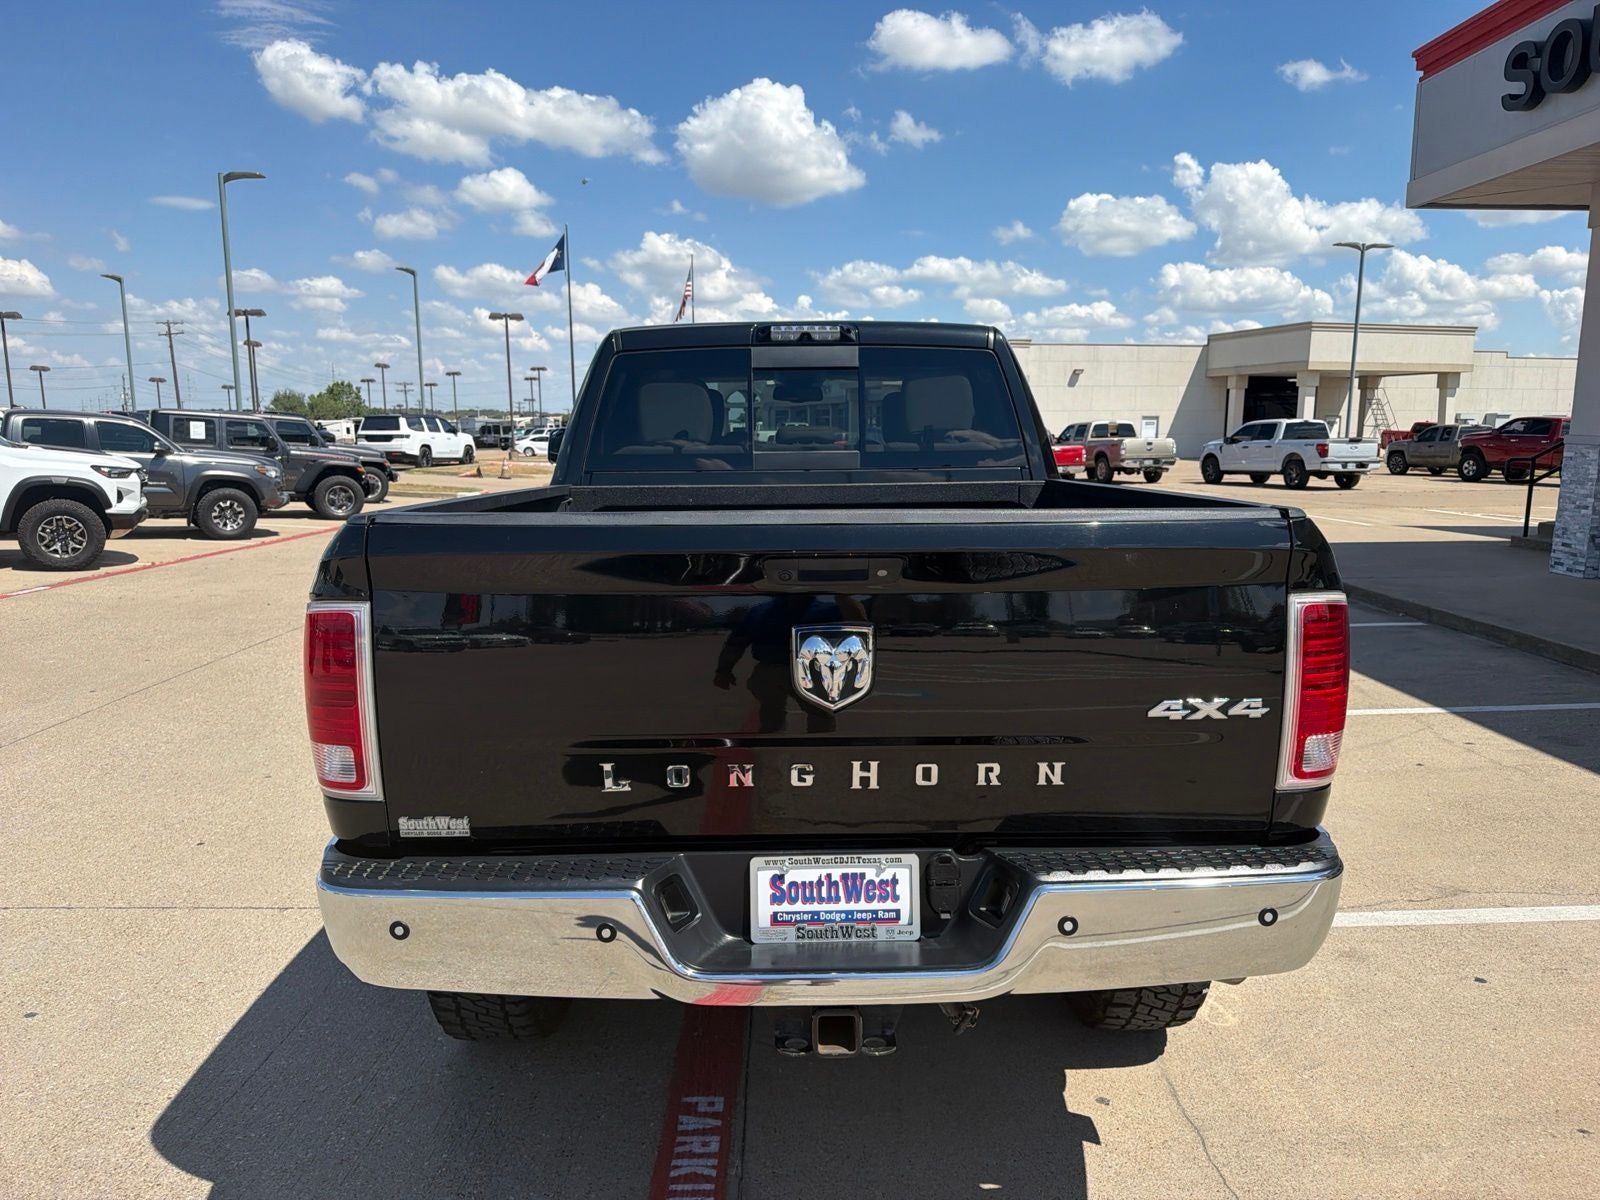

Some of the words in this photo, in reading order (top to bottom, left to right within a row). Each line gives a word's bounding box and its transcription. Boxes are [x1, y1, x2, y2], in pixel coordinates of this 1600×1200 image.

[599, 760, 1066, 792] LONGHORN
[398, 816, 470, 830] SouthWest
[764, 856, 902, 866] wwwSouthWestCDJRTexascom
[769, 872, 901, 906] SouthWest
[777, 912, 812, 922] Chrysler
[820, 911, 846, 921] Dodge
[853, 911, 872, 921] Jeep
[878, 910, 897, 919] Ram
[796, 925, 877, 940] SouthWest
[666, 1096, 725, 1200] PARKI
